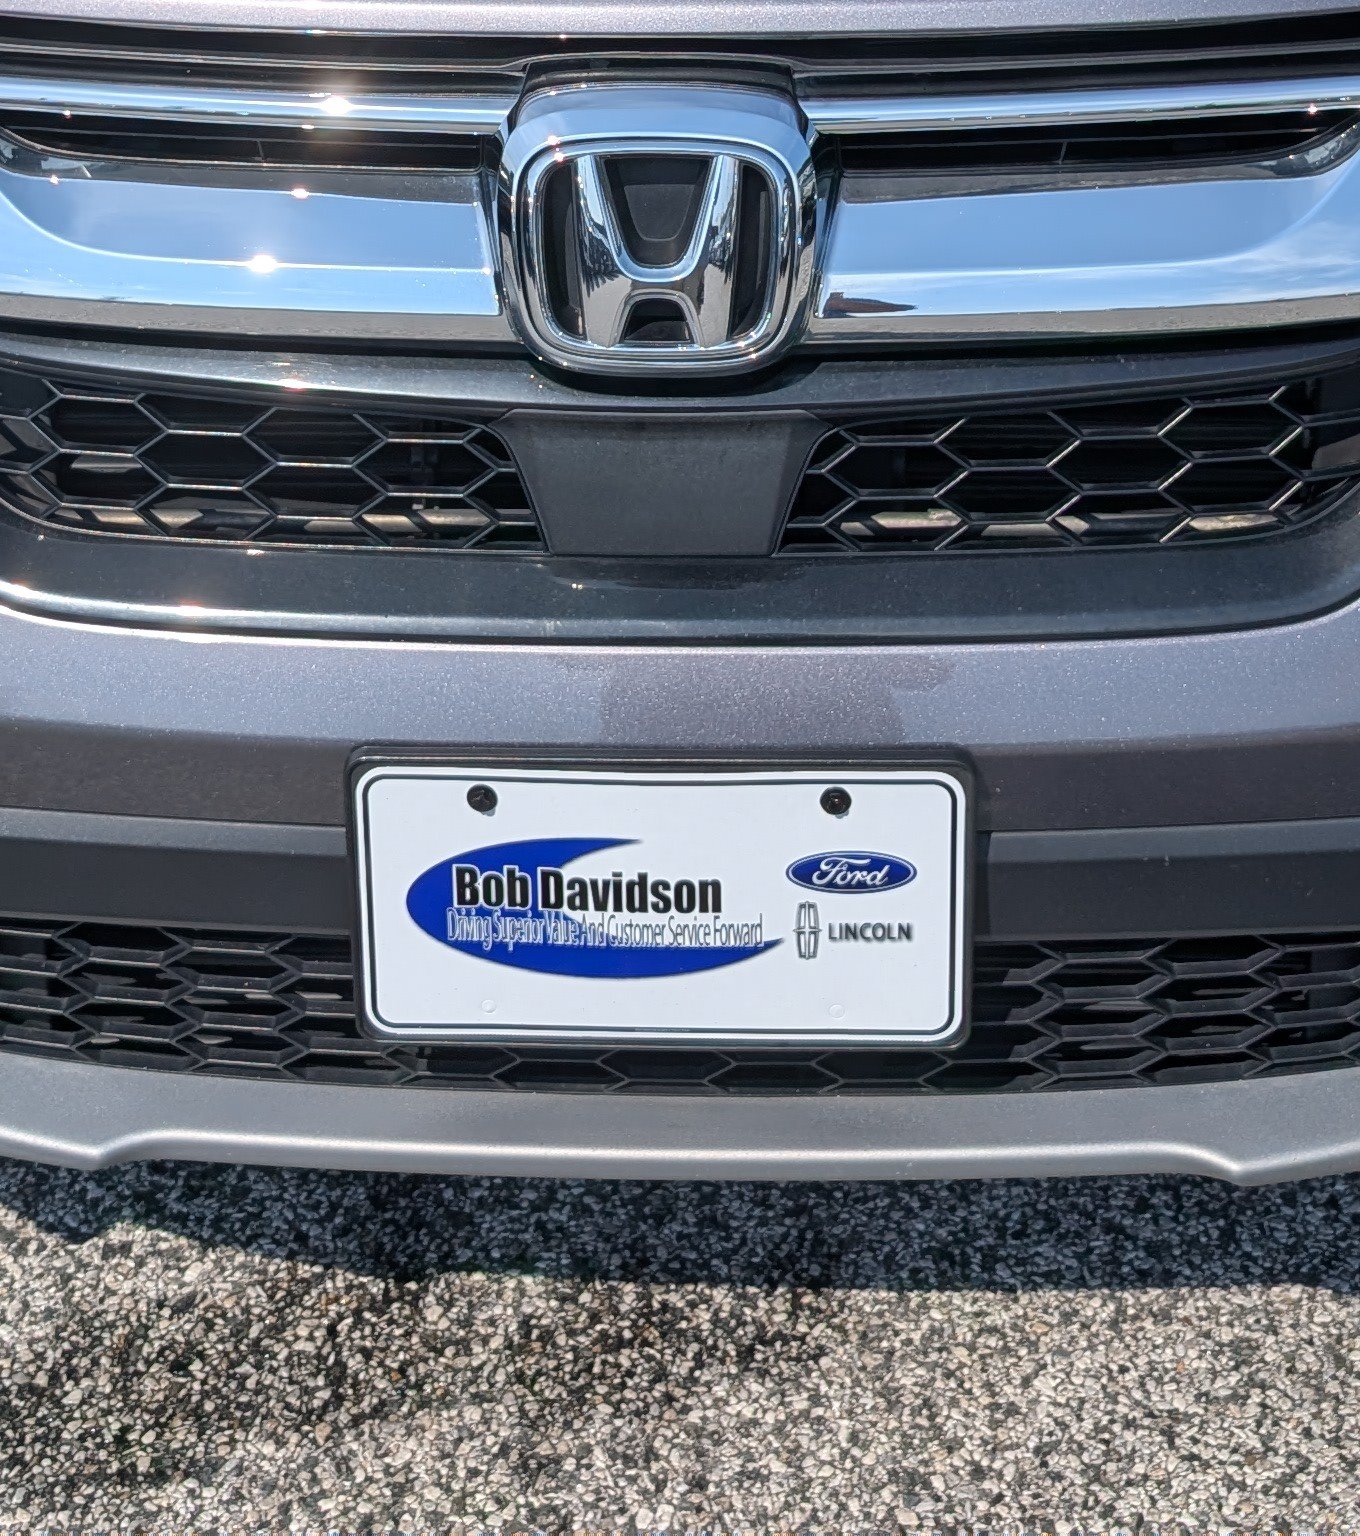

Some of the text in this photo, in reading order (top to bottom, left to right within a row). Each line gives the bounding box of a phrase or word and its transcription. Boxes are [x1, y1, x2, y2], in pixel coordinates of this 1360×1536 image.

[453, 864, 722, 914] Bob Davidson
[811, 856, 891, 886] Ford
[447, 908, 764, 952] Driving Superior Value And Customer Service Forward
[828, 922, 913, 943] LINCOLN
